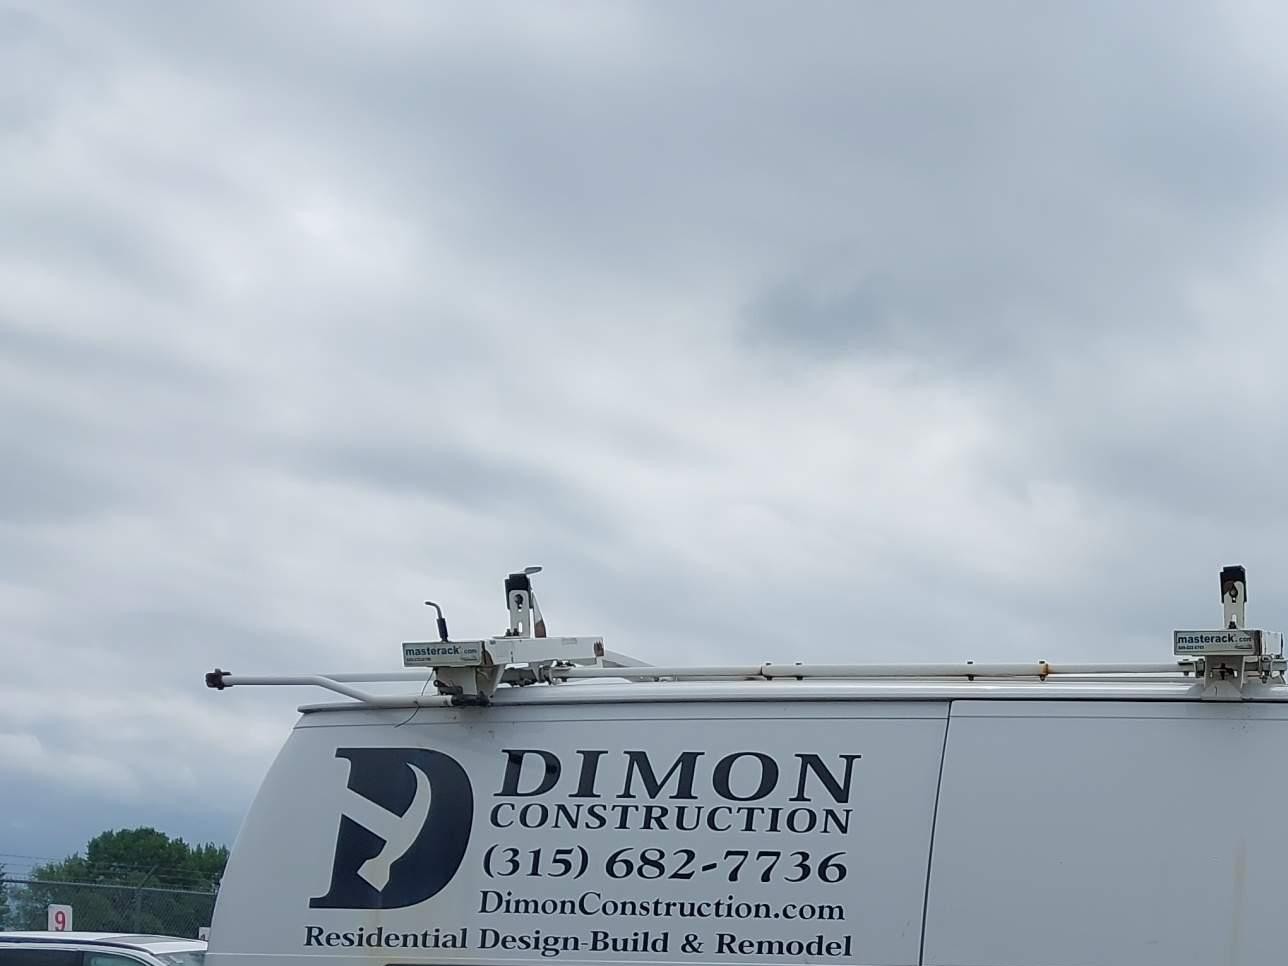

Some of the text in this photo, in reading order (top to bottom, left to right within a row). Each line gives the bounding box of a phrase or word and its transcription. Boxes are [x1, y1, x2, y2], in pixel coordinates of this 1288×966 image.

[493, 749, 862, 804] DIMON
[490, 802, 853, 835] CONSTRUCTION
[483, 844, 847, 883] (315) 682-7736
[54, 910, 66, 932] 9
[479, 890, 845, 921] DimonConstruction.com
[304, 926, 852, 957] Residential Design-Build & Remodel
